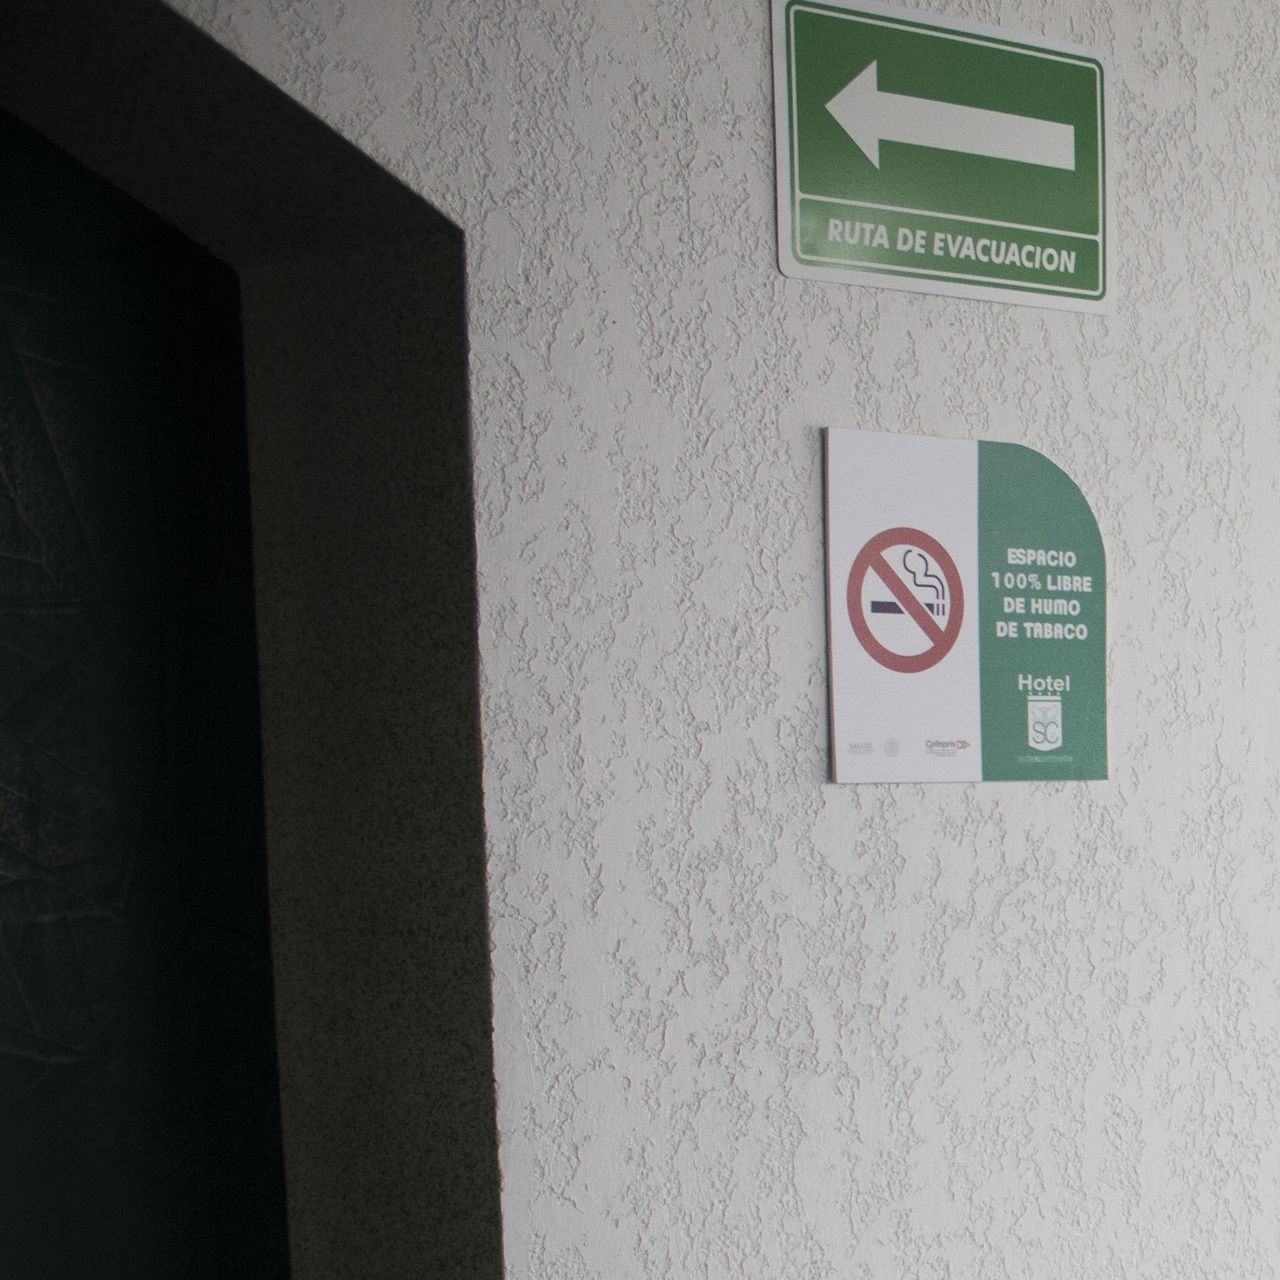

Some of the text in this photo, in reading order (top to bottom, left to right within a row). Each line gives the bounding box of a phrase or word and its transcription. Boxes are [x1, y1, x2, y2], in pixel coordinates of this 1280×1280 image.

[827, 218, 1077, 274] RUTA DE EVACUACION
[1007, 548, 1077, 568] ESPACIO
[991, 571, 1092, 593] 100% LIBRE
[1003, 597, 1081, 616] DE HUMO
[996, 621, 1088, 640] DE TABACO
[1018, 673, 1071, 692] Hotel
[1032, 721, 1060, 744] SC
